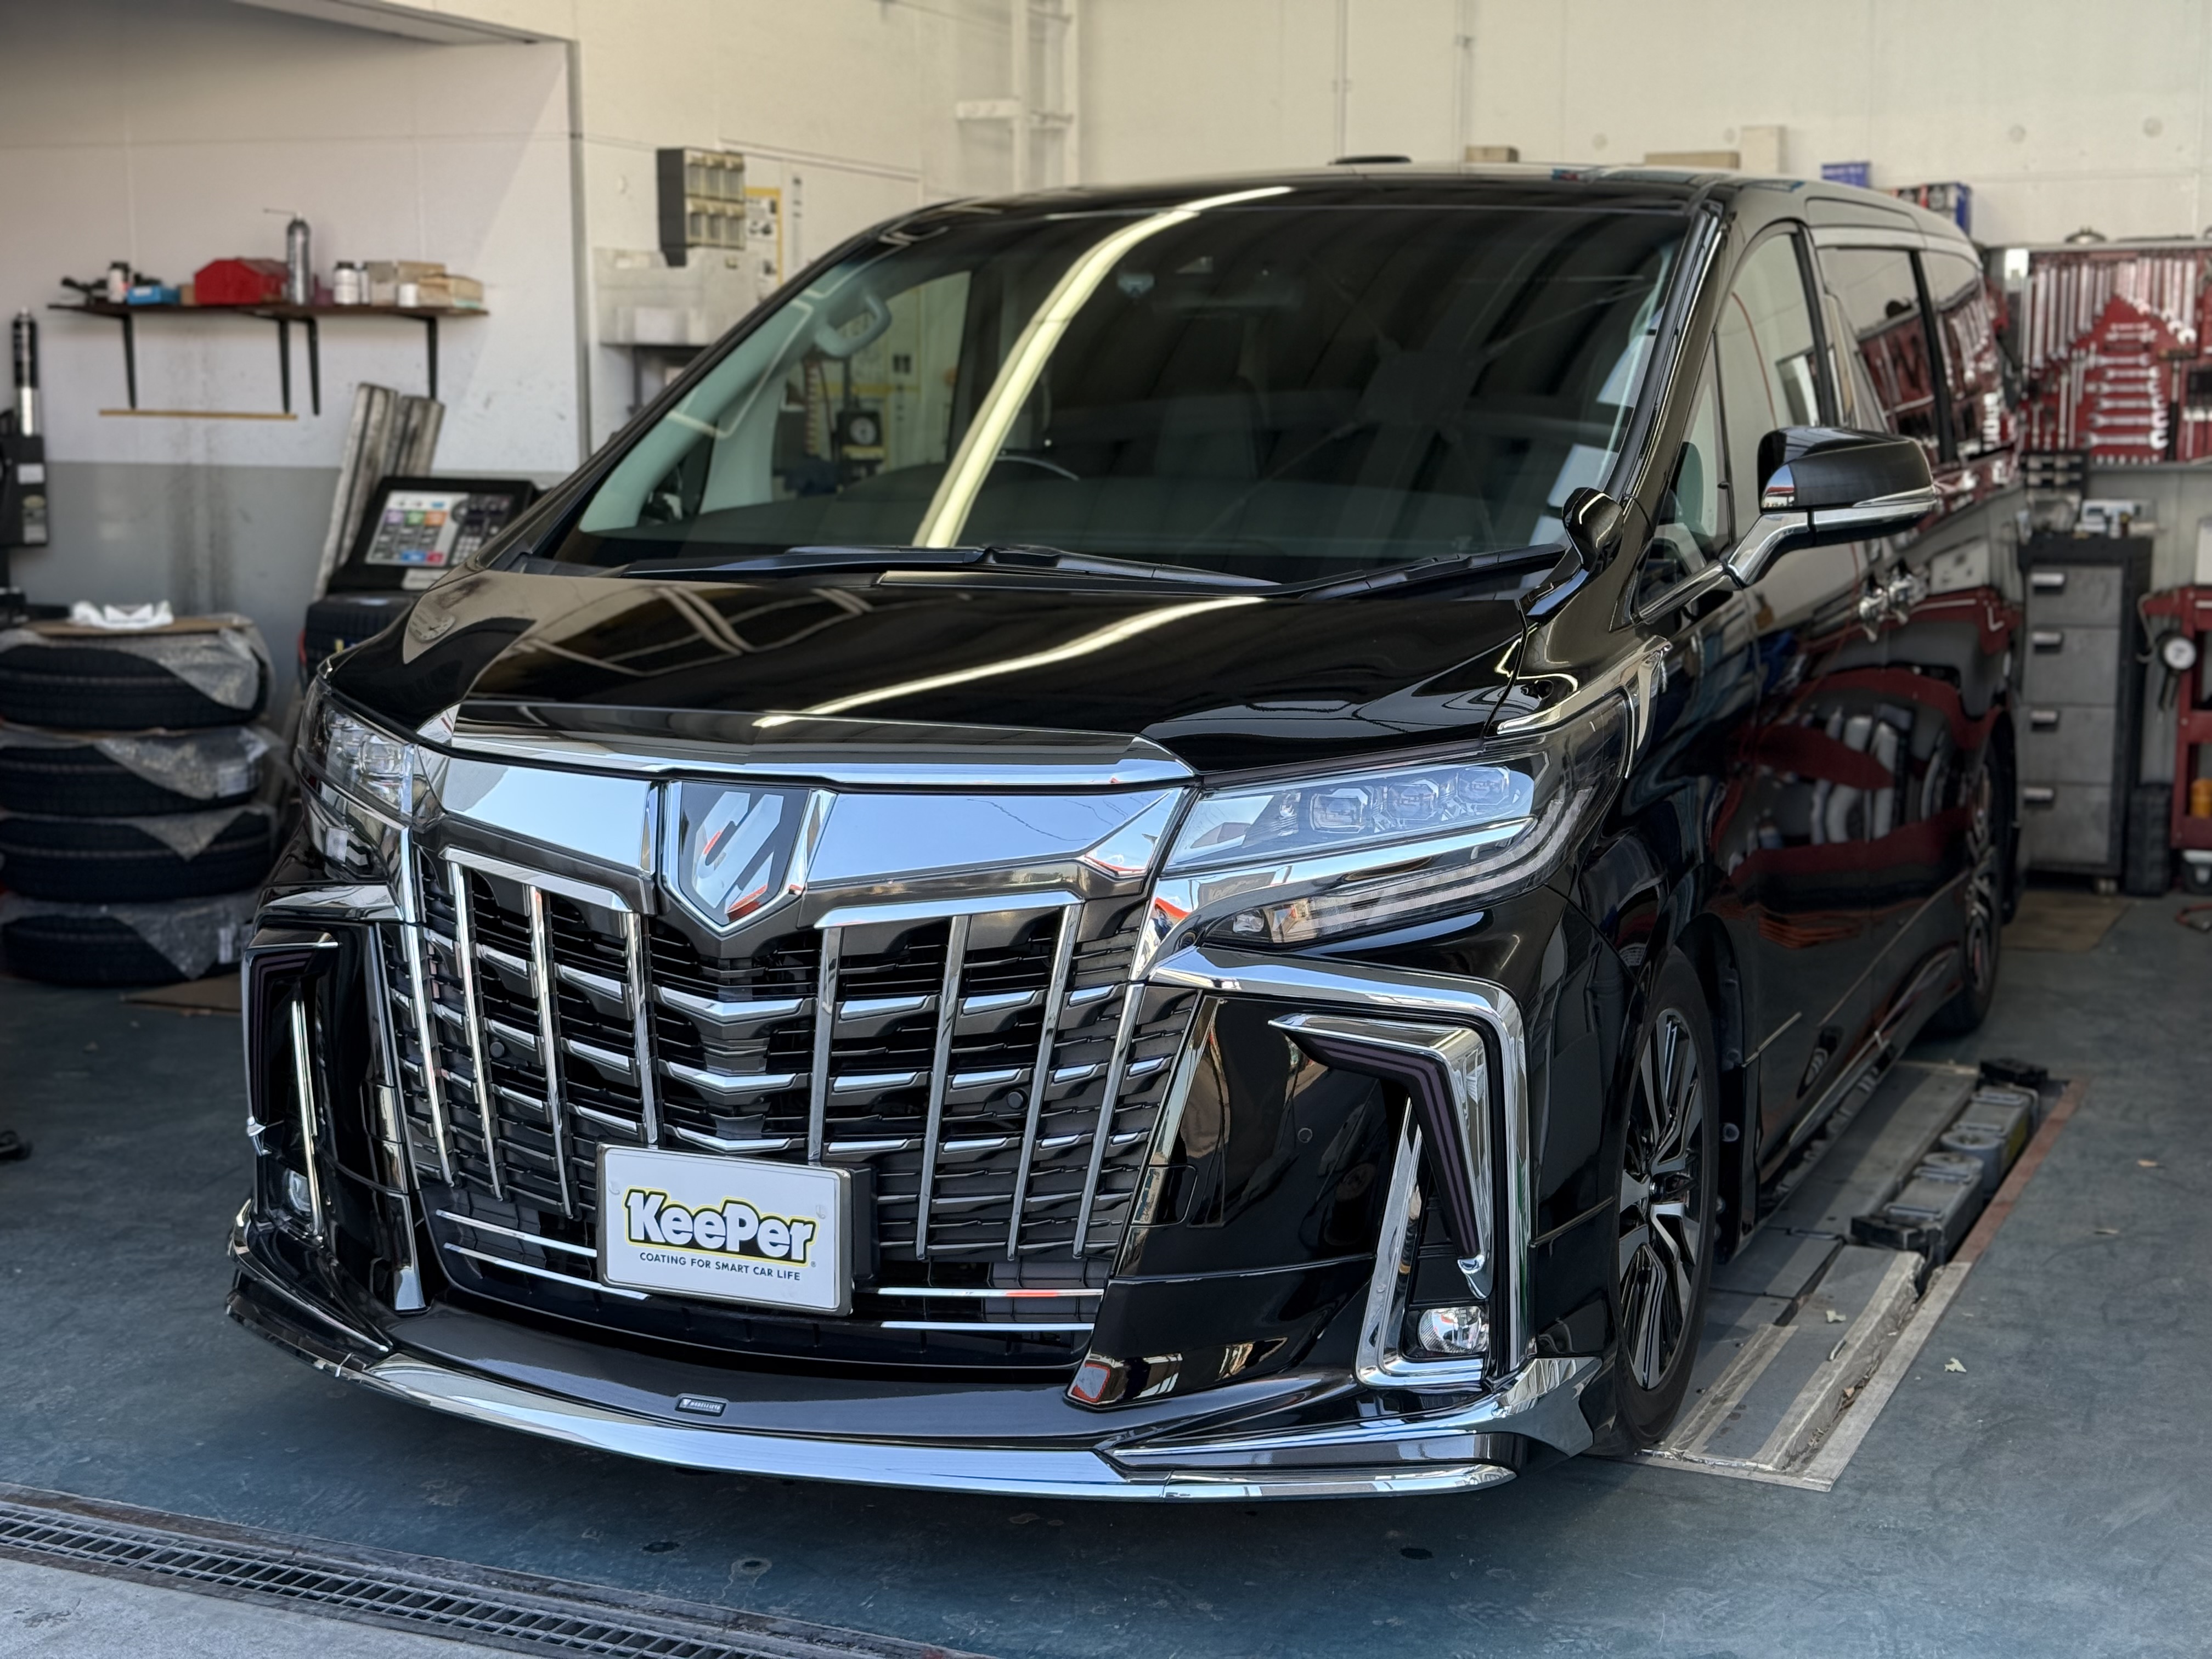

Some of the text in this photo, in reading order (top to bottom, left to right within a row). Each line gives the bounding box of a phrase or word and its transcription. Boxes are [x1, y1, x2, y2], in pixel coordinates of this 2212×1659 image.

[624, 1188, 816, 1263] KeePer
[640, 1252, 800, 1281] COATING FOR SMART CAR LIFE
